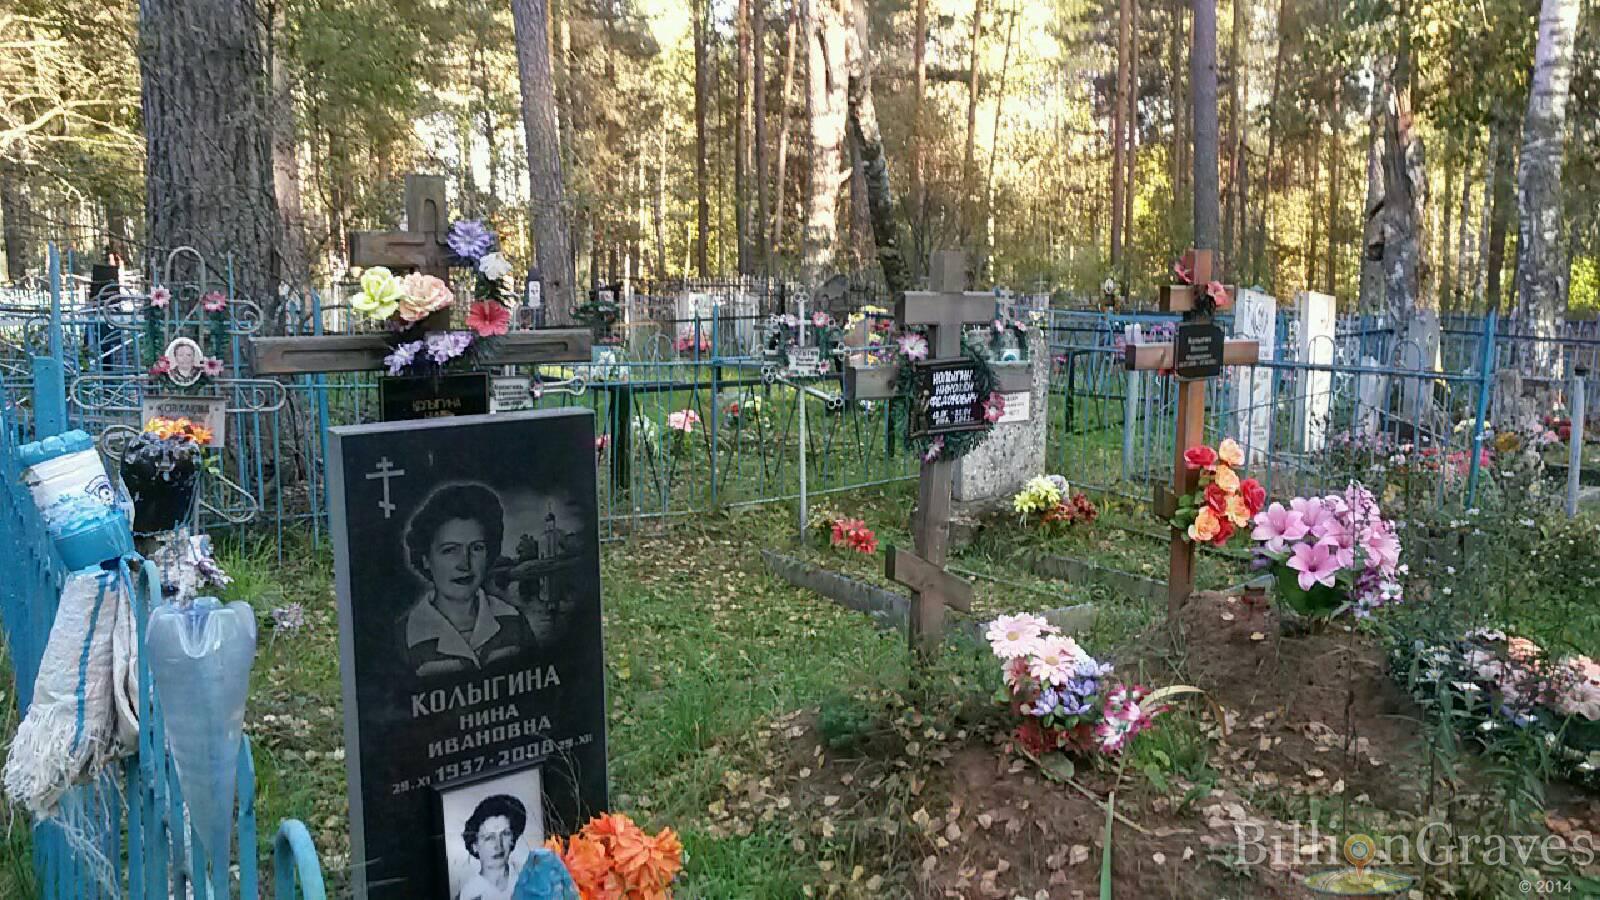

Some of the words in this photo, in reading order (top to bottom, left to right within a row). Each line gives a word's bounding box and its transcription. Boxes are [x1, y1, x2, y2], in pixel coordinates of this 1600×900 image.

[411, 664, 561, 718] КОЛЫГИНА
[428, 715, 552, 758] ИВАНОВНА
[459, 704, 519, 731] НИНА
